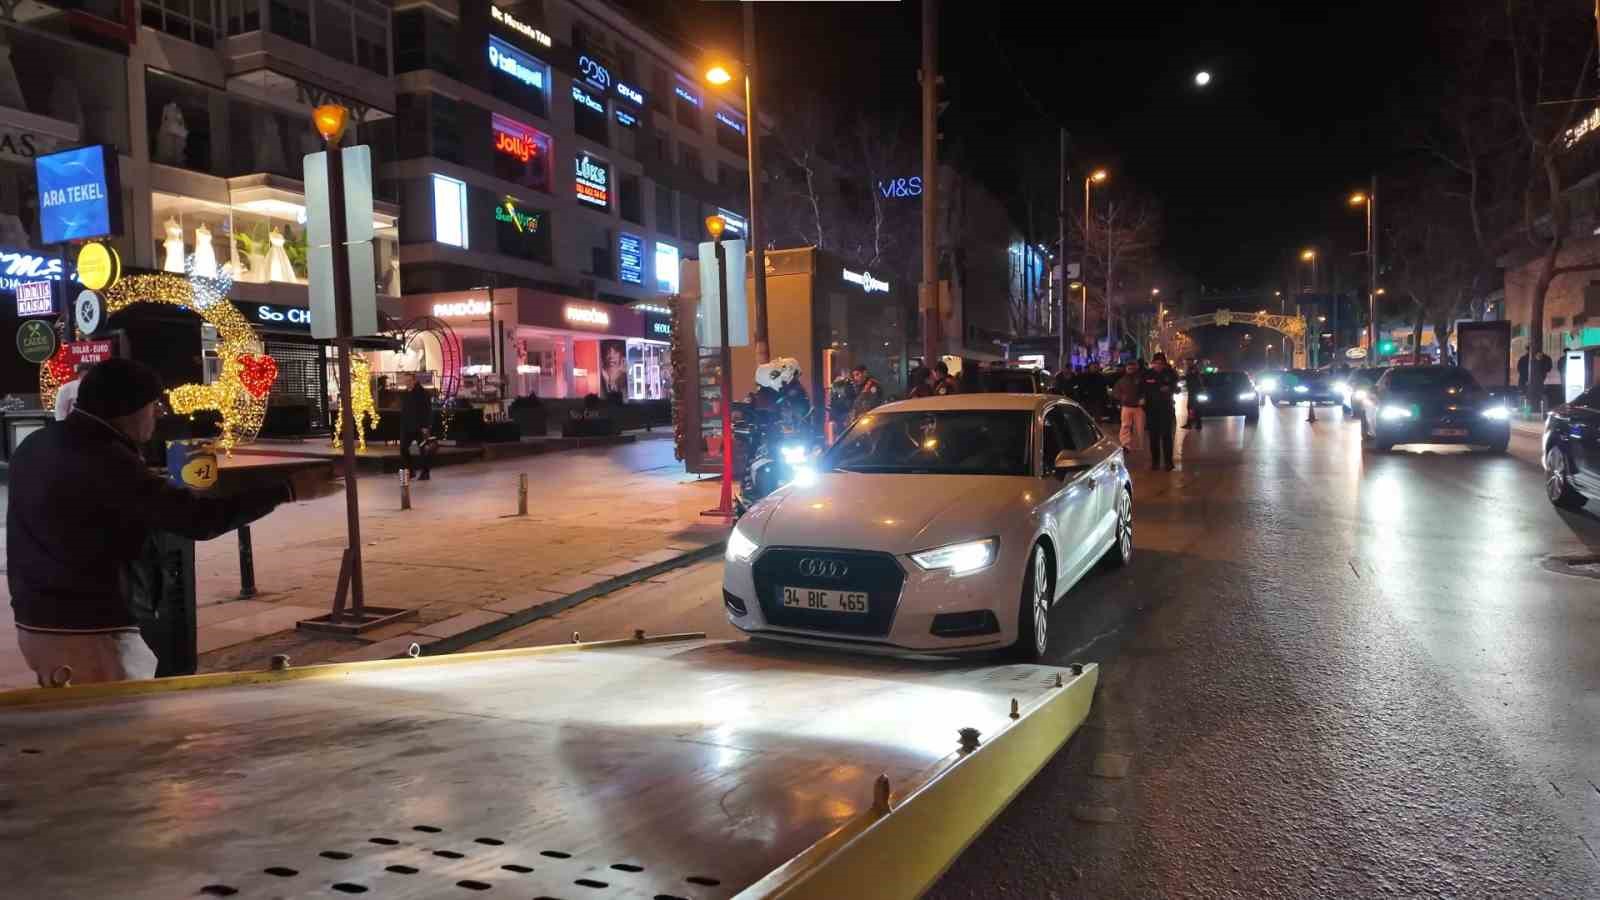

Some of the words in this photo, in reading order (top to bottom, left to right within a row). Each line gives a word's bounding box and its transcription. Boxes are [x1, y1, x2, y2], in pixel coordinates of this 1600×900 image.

[496, 133, 530, 161] Jolly
[43, 189, 66, 208] ARA
[66, 182, 104, 203] TEKEL
[258, 306, 284, 321] So
[784, 589, 800, 606] 34
[808, 591, 829, 609] BIC
[839, 593, 865, 612] 465
